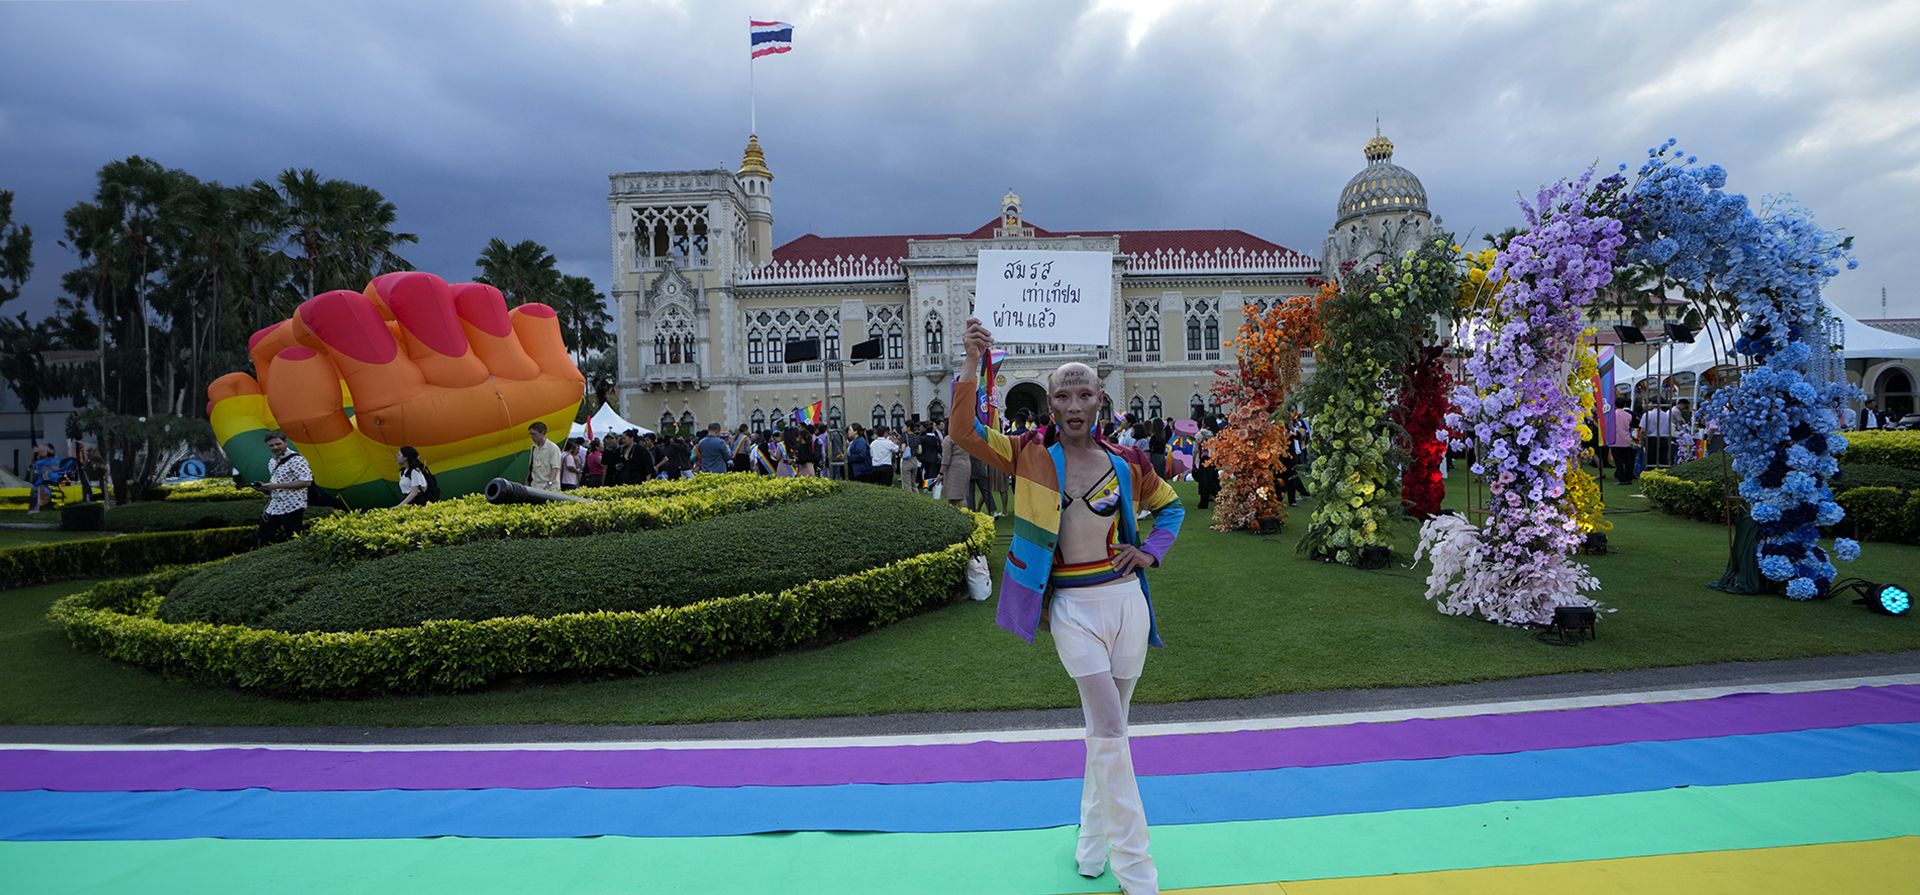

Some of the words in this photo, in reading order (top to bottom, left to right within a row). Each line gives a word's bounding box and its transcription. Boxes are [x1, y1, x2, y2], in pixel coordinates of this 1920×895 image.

[1004, 260, 1054, 280] สมรส
[1022, 280, 1081, 304] เท่าเทียม
